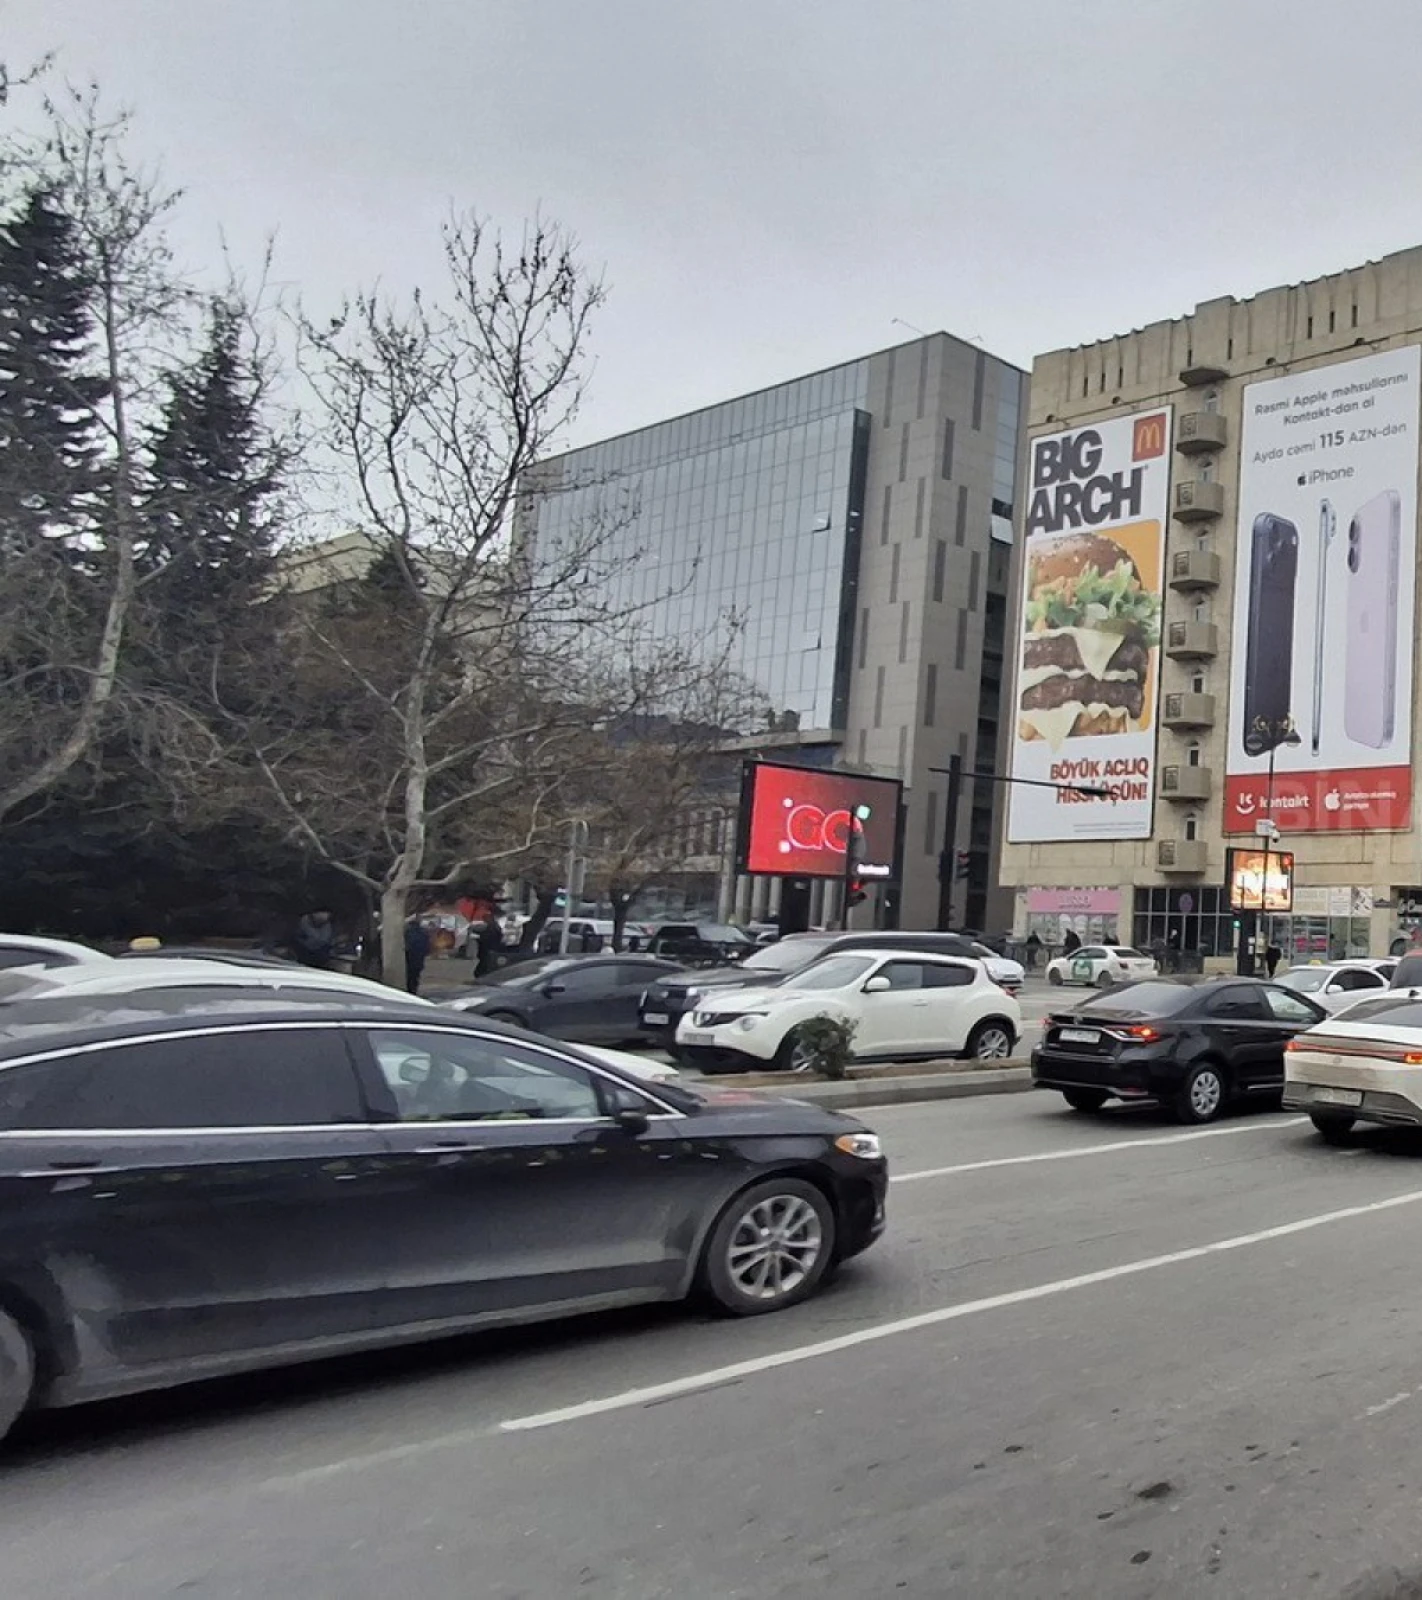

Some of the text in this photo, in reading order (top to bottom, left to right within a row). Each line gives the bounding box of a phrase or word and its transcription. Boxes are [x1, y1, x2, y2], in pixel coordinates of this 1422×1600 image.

[1293, 391, 1327, 408] Apple
[1319, 430, 1345, 449] 115
[1034, 429, 1103, 488] BIG
[1308, 466, 1355, 485] iPhone
[1026, 467, 1143, 537] ARCH
[1050, 757, 1149, 780] BÖYÜK ACLIQ
